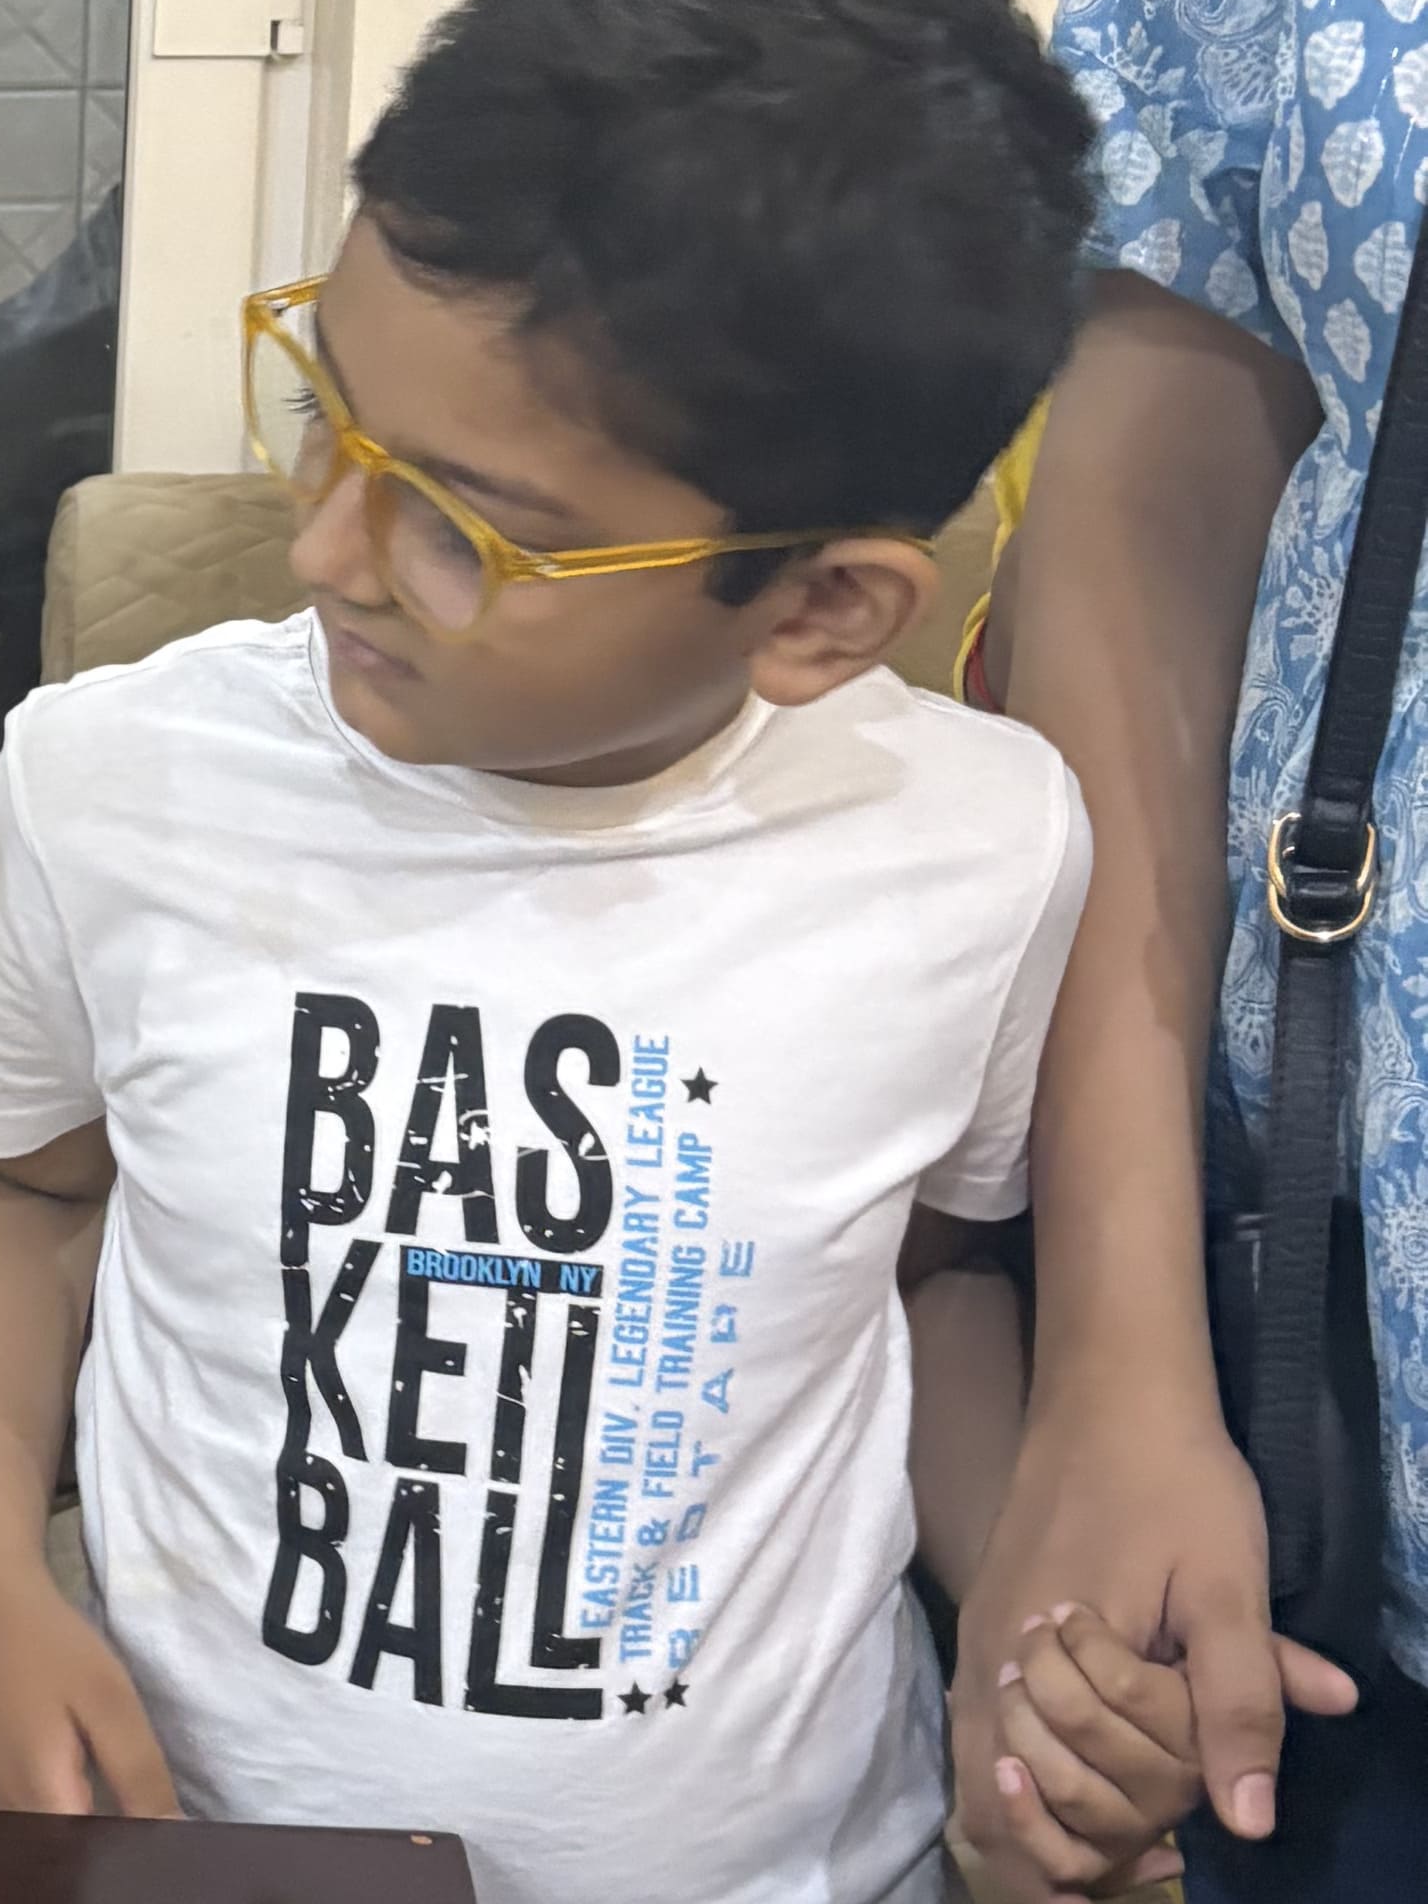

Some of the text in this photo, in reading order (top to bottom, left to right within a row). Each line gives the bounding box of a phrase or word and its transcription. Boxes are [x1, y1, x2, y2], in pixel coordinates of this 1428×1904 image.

[279, 990, 622, 1268] BAS
[406, 1248, 602, 1295] BROOKLYN NY
[580, 1034, 670, 1629] EASTERN DIV. LEGENDARY LEAGUE
[619, 1131, 713, 1665] TRACK & FIELD TRAINING CAMP
